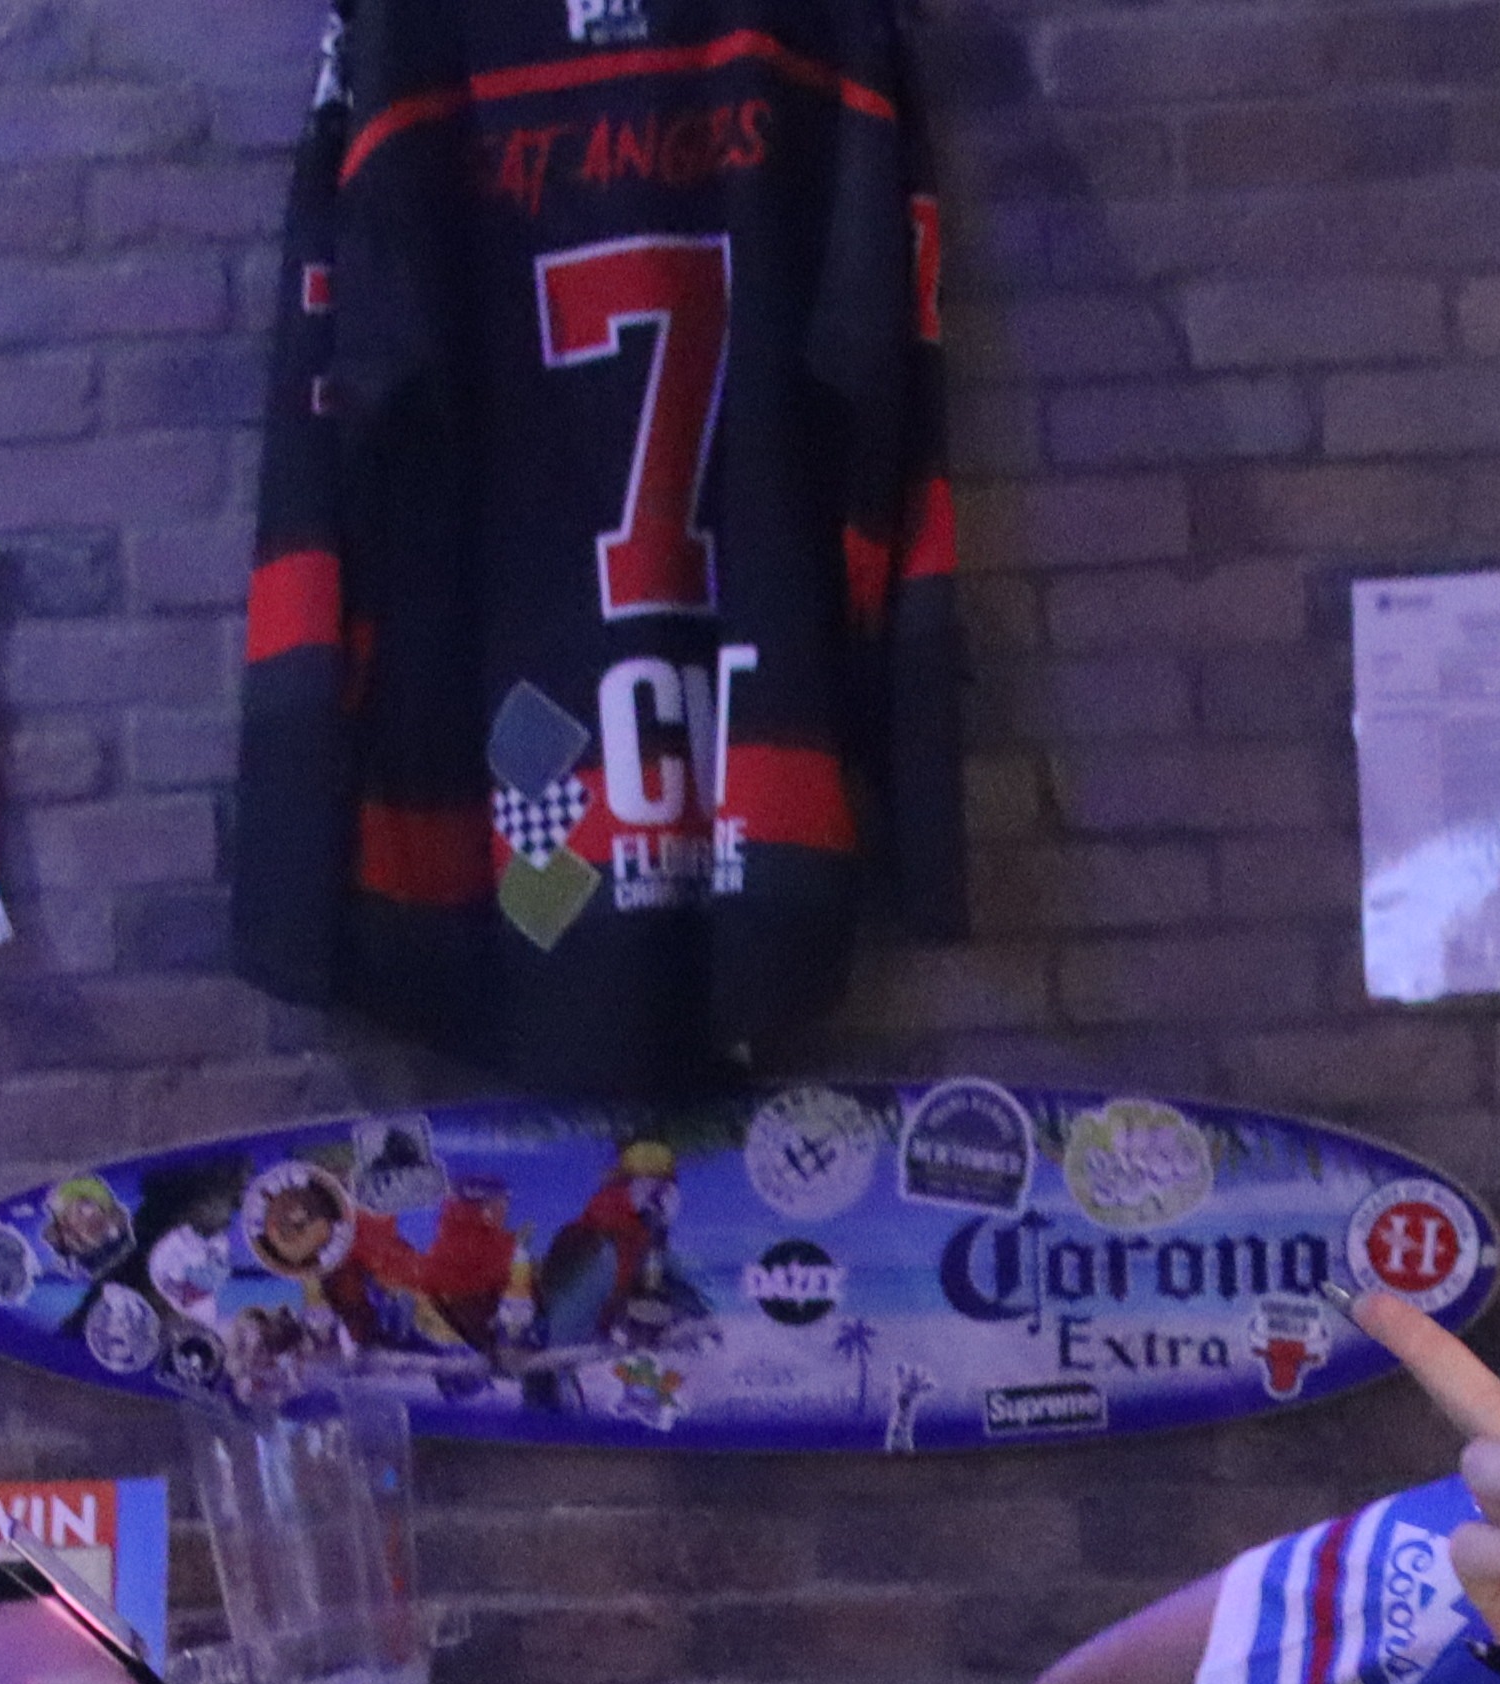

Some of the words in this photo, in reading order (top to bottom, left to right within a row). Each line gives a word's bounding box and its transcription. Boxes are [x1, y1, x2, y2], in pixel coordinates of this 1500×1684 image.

[535, 233, 731, 620] 7
[940, 1208, 1330, 1335] Corona
[1059, 1312, 1229, 1371] Extra
